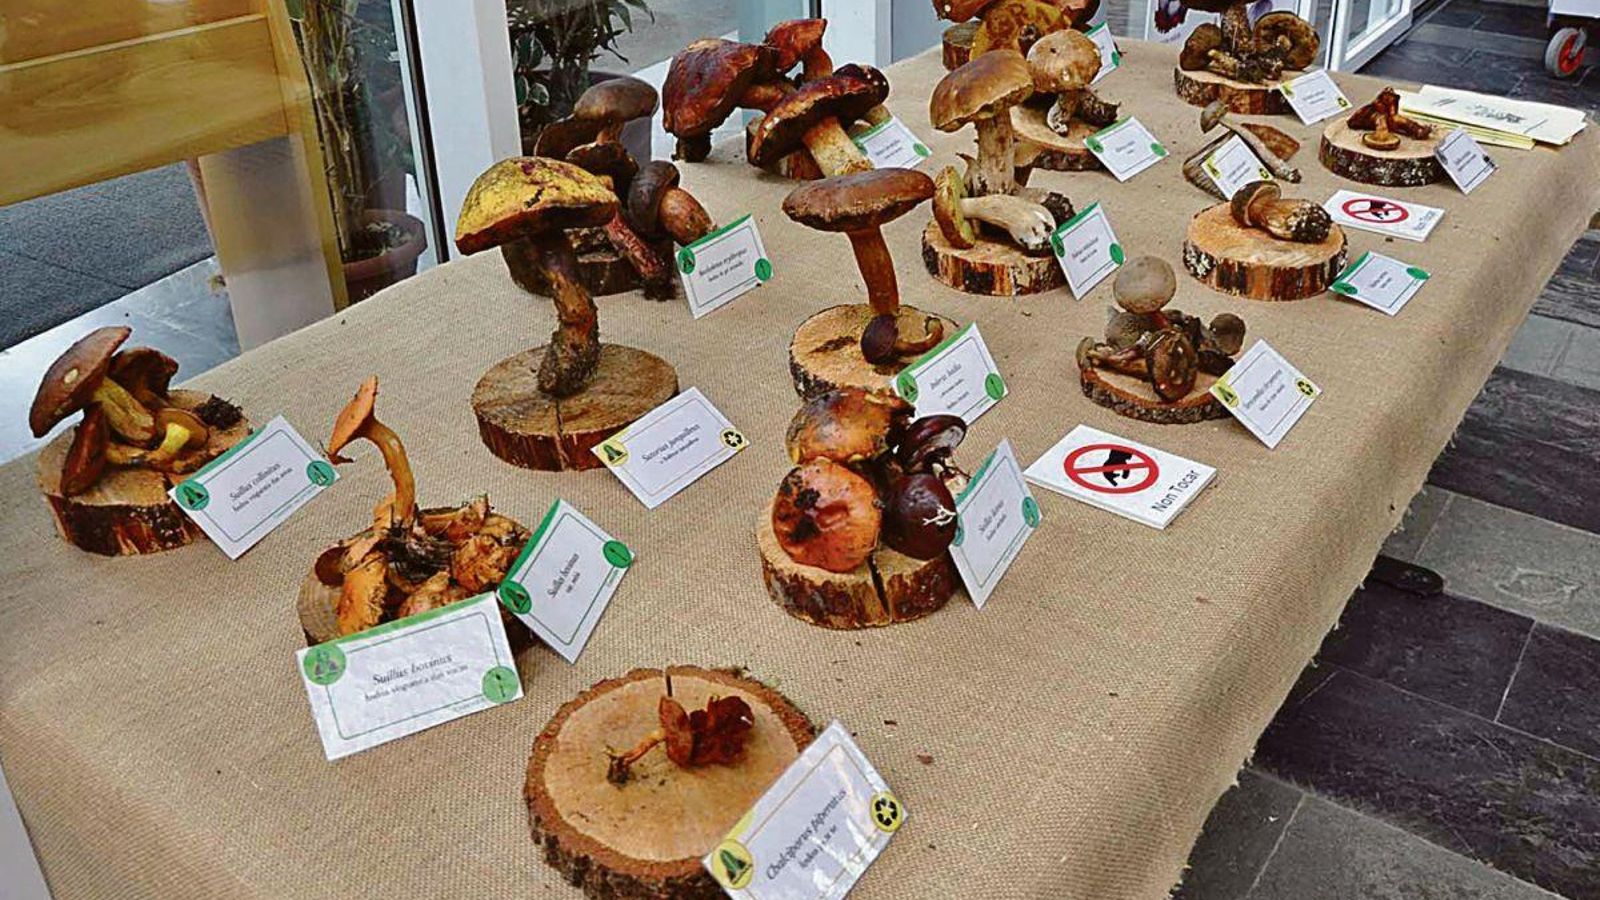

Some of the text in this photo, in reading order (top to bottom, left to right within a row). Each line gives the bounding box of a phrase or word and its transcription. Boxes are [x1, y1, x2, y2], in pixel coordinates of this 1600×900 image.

[641, 442, 669, 462] Sutorius
[229, 480, 252, 501] Suillus
[1151, 469, 1202, 513] Non Tocar
[372, 653, 453, 686] Suillus bovinus
[766, 826, 812, 881] Chalciporus
[811, 788, 848, 833] piperatus
